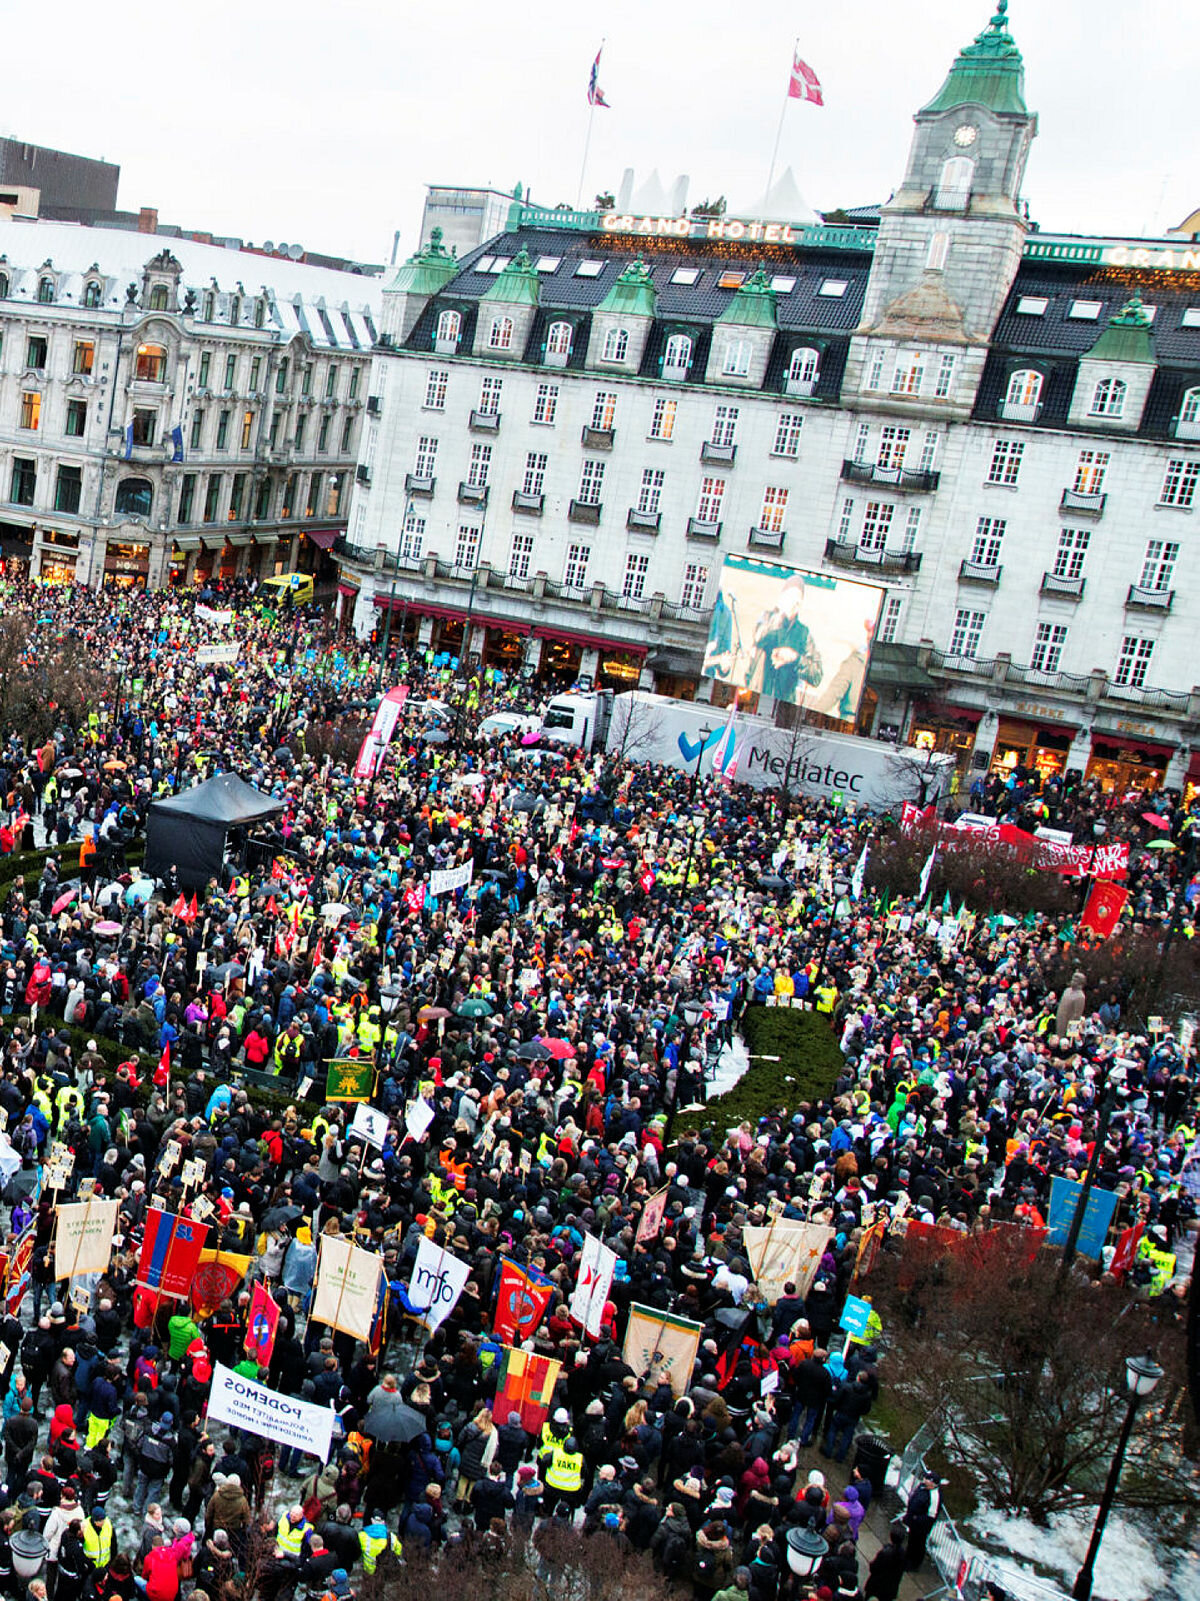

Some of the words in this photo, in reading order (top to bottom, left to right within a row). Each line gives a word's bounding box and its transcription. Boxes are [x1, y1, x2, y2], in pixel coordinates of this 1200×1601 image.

[602, 213, 691, 237] GRAND
[707, 219, 796, 243] HOTEL
[97, 362, 109, 424] HOTEL
[748, 745, 864, 793] Mediatec
[417, 1267, 453, 1304] mfo
[556, 1459, 577, 1471] VAKT
